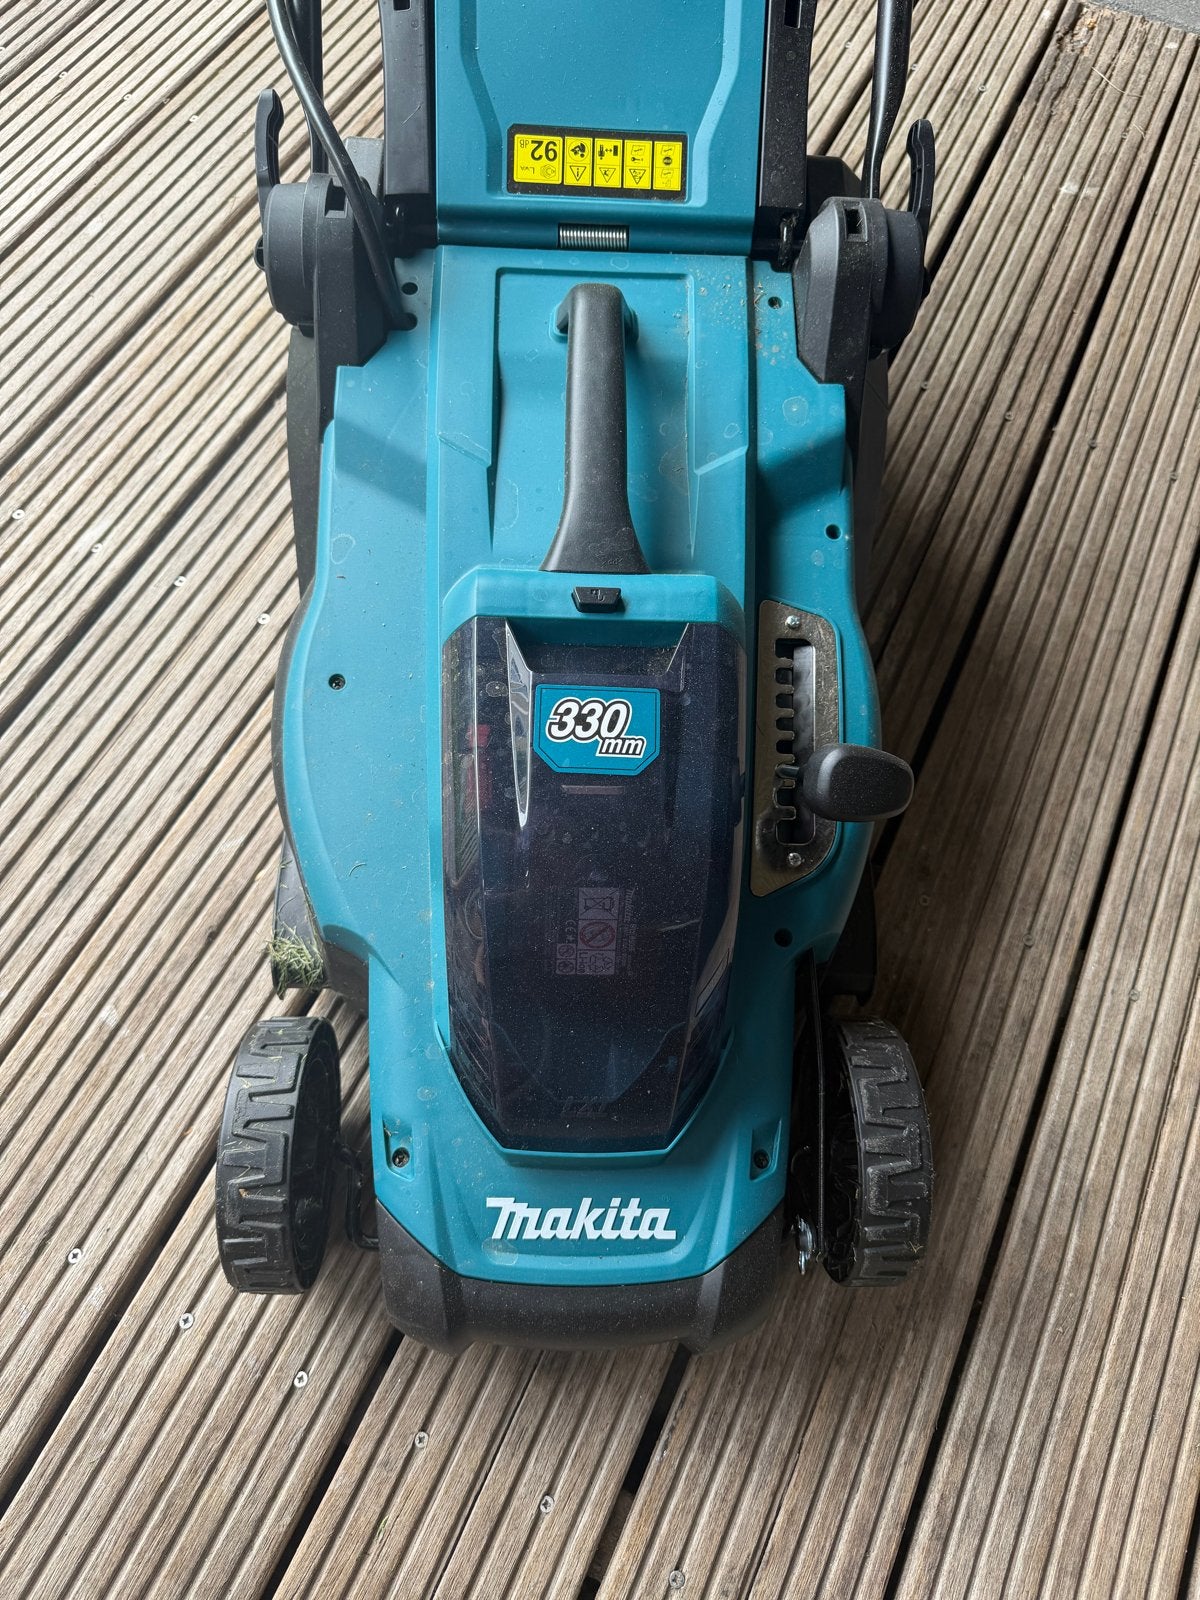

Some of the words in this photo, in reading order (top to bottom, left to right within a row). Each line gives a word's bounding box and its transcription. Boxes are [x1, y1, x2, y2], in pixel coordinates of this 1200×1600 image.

[519, 139, 530, 149] dB
[530, 140, 558, 162] 92
[545, 697, 632, 742] 330
[596, 736, 646, 758] mm
